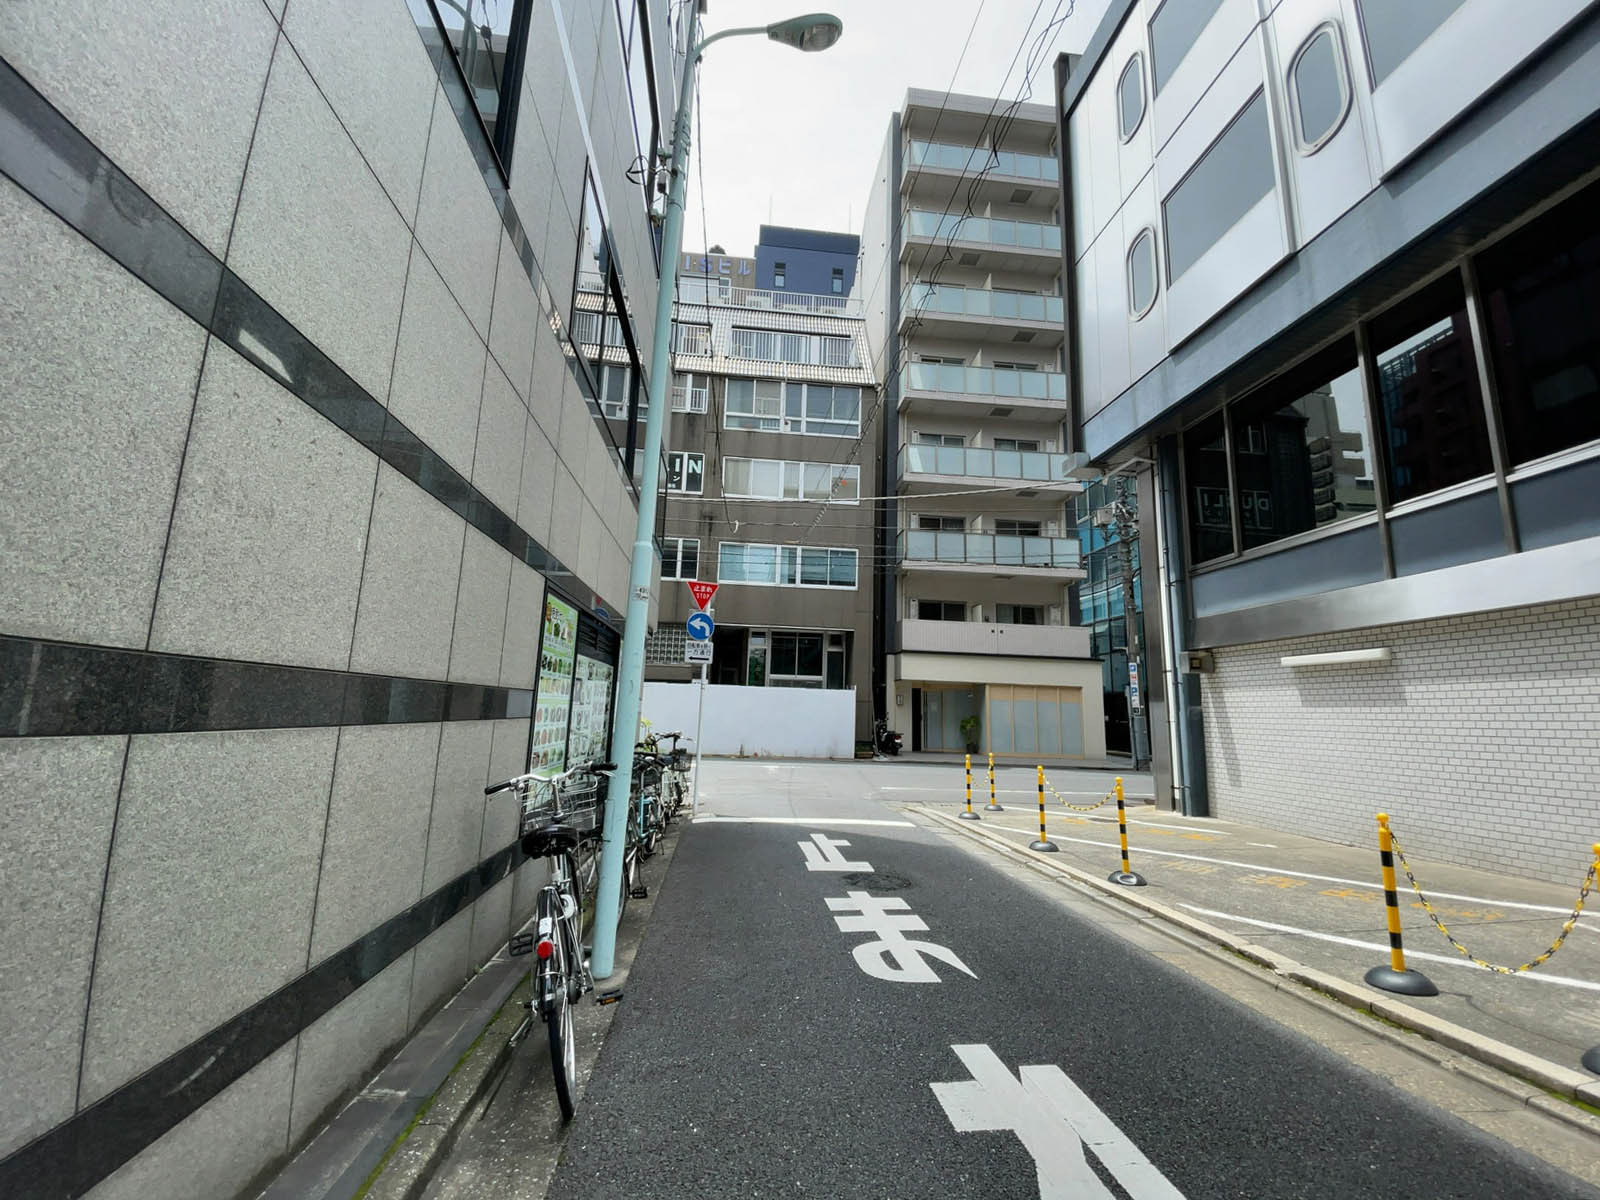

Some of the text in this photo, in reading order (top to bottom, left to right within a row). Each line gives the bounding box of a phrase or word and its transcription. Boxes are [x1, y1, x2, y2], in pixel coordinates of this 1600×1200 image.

[668, 458, 702, 474] IN
[693, 584, 713, 593] 止まれ
